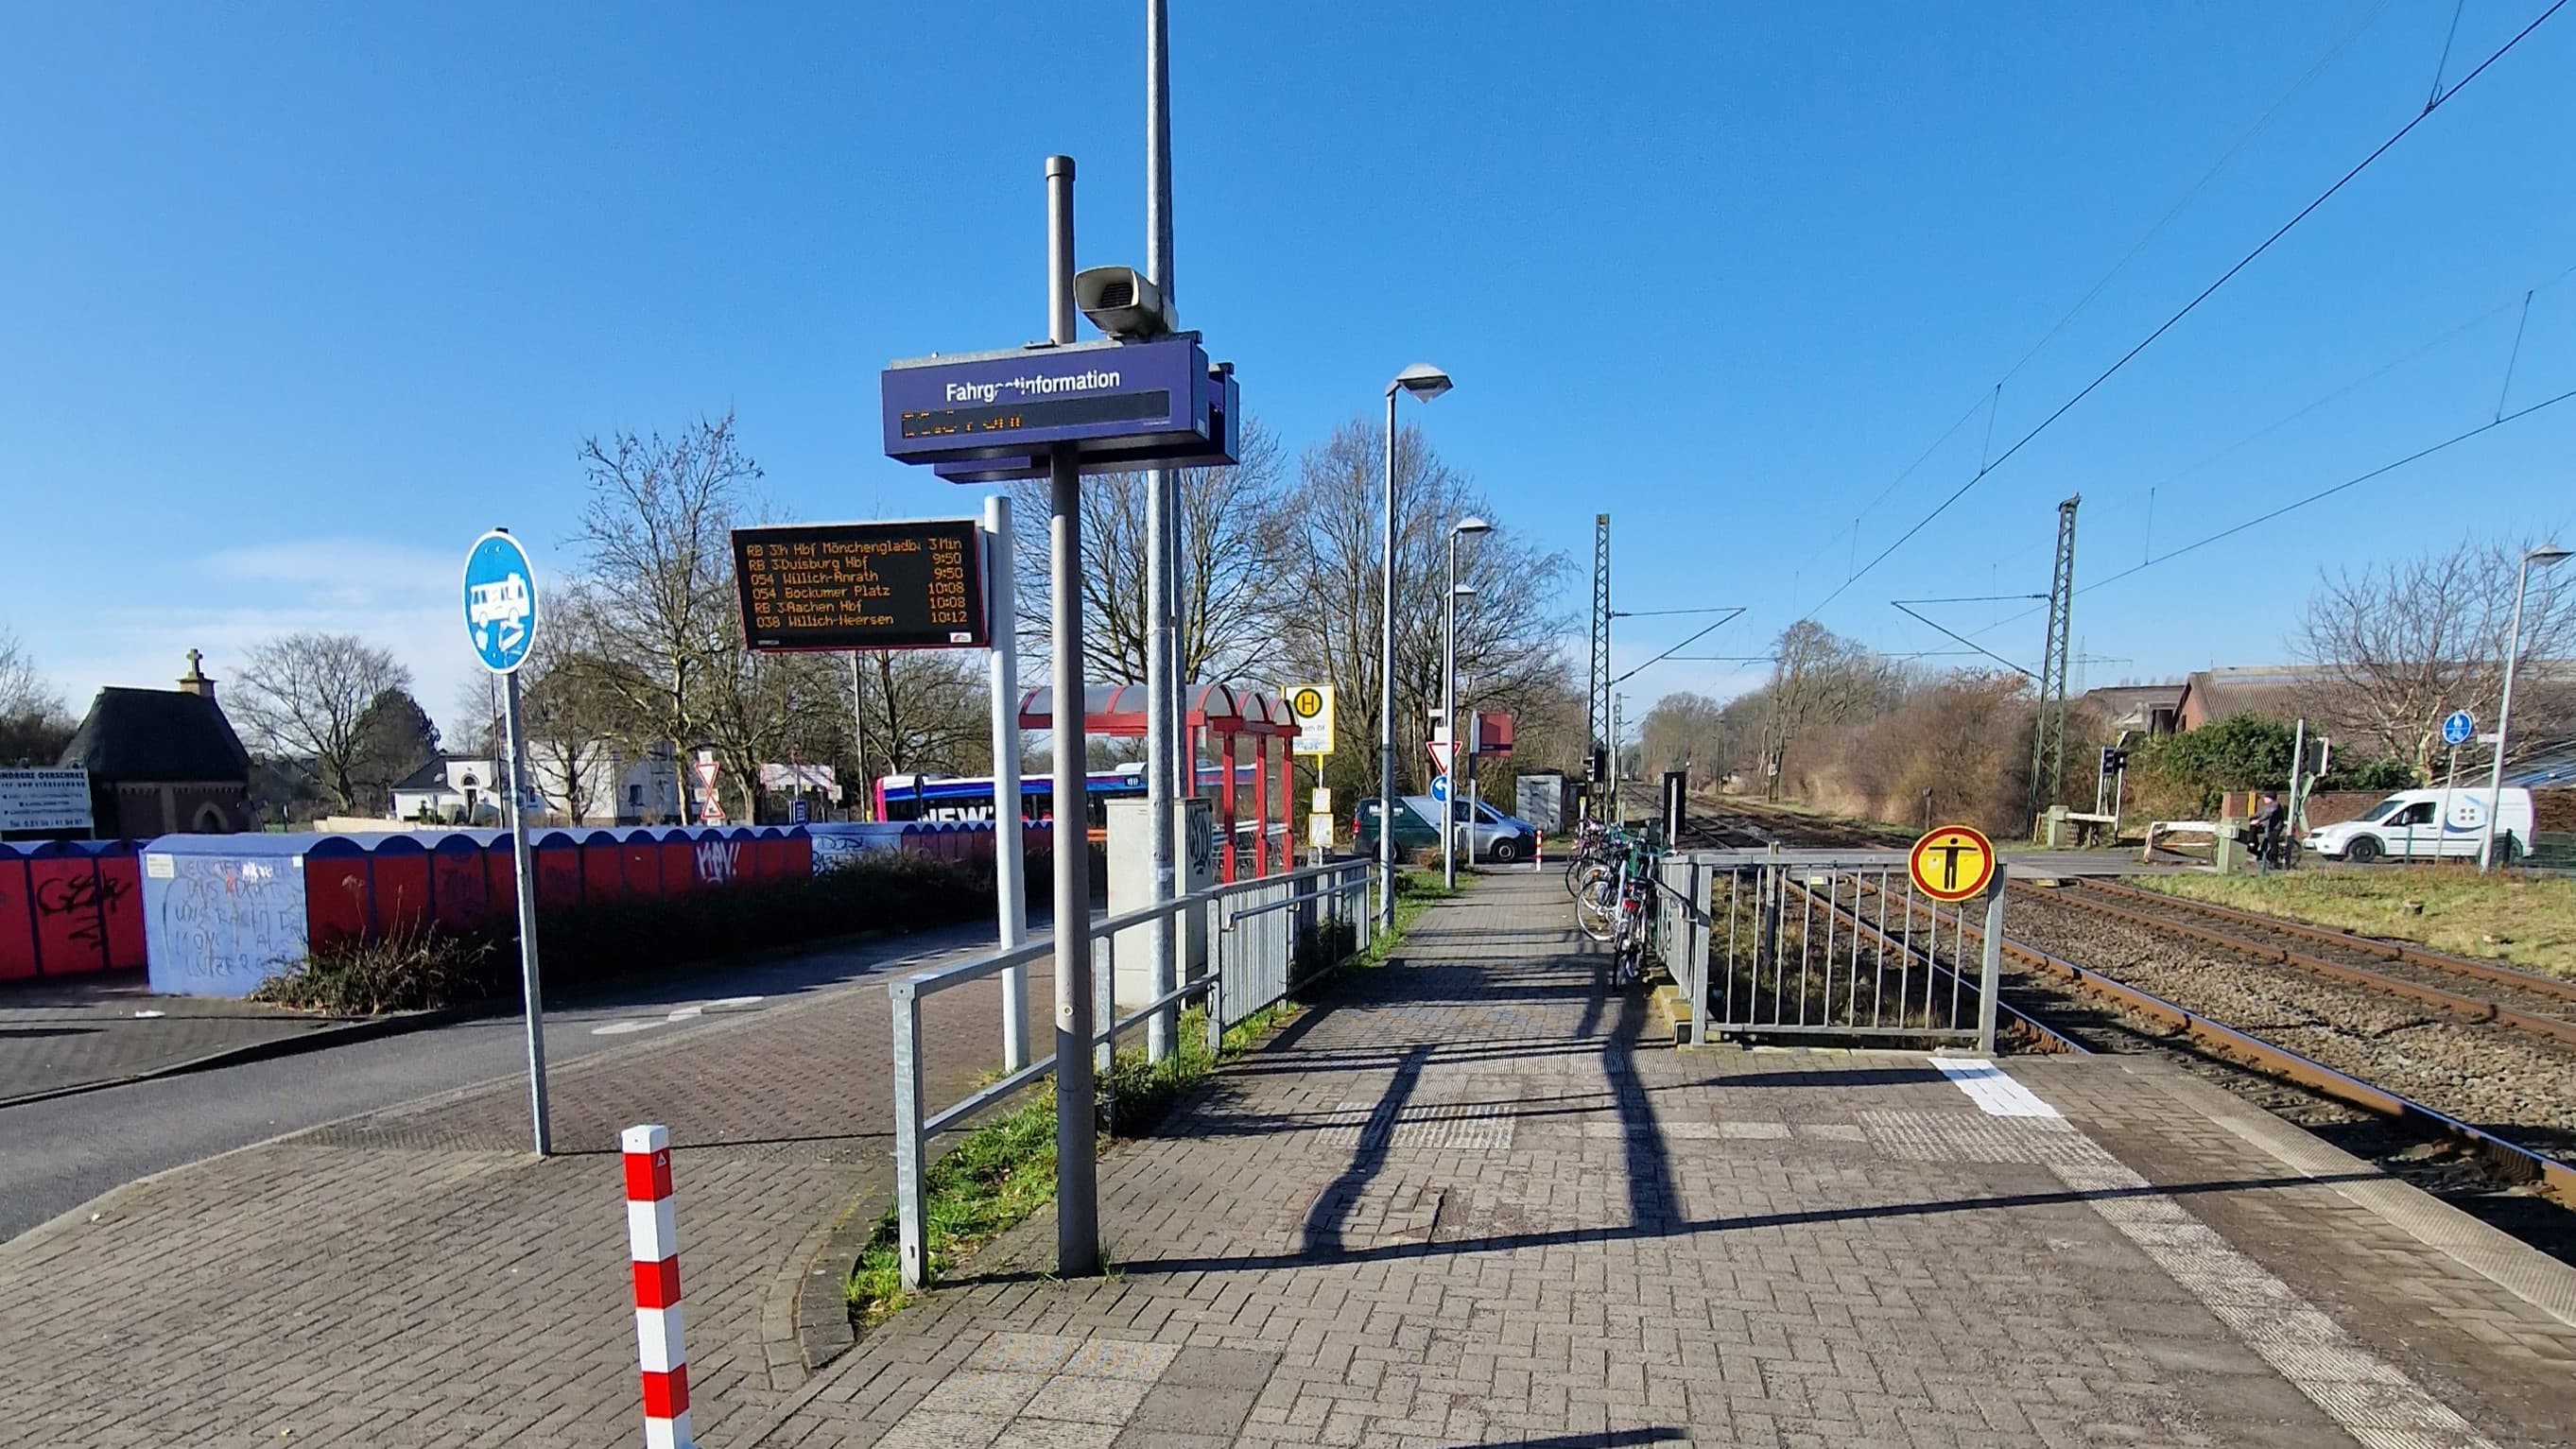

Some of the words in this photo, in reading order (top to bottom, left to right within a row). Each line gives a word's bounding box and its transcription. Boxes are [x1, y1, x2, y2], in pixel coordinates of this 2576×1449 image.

[932, 552, 962, 564] 9:50
[751, 574, 774, 585] 054
[783, 570, 879, 584] Willich-Anrath
[934, 567, 964, 579] 9:50
[752, 588, 777, 599] 054
[785, 586, 848, 599] Bockumer
[854, 584, 891, 596] Platz
[927, 581, 965, 595] 10:08
[839, 598, 862, 612] Hbf
[929, 596, 966, 610] 10:08
[931, 611, 968, 624] 10:12
[1301, 695, 1315, 712] H
